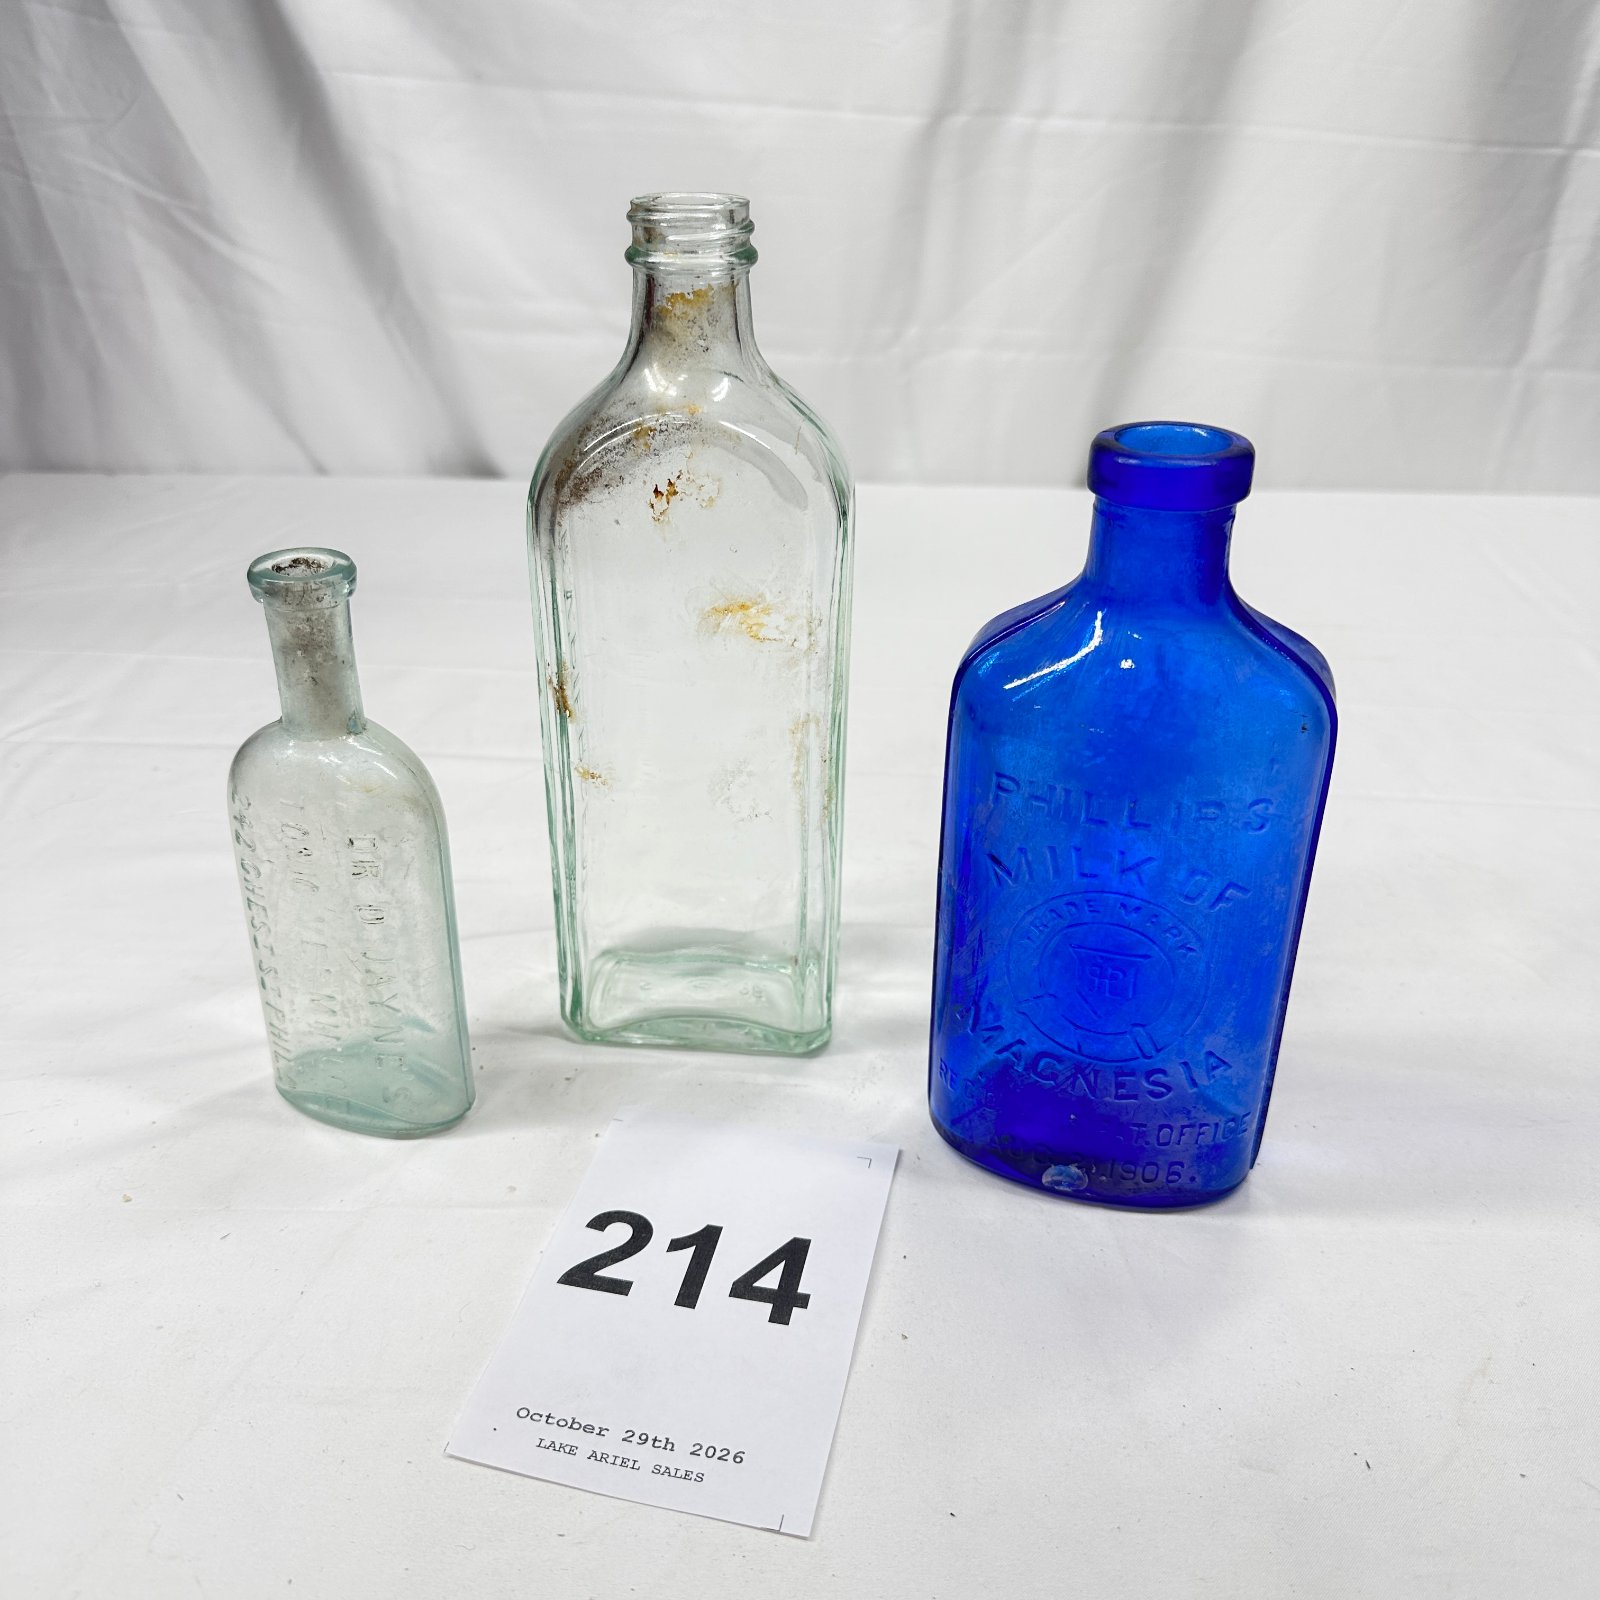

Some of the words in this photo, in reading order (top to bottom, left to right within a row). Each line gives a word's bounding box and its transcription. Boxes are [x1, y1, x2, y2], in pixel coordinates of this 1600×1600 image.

[984, 843, 1158, 889] MILK
[1177, 868, 1253, 913] OF
[557, 1209, 812, 1327] 214
[515, 1406, 610, 1439] October
[621, 1429, 676, 1453] 29th
[689, 1441, 747, 1466] 2026
[536, 1437, 580, 1457] LAKE
[586, 1449, 641, 1472] ARIEL
[650, 1462, 706, 1484] SALES
